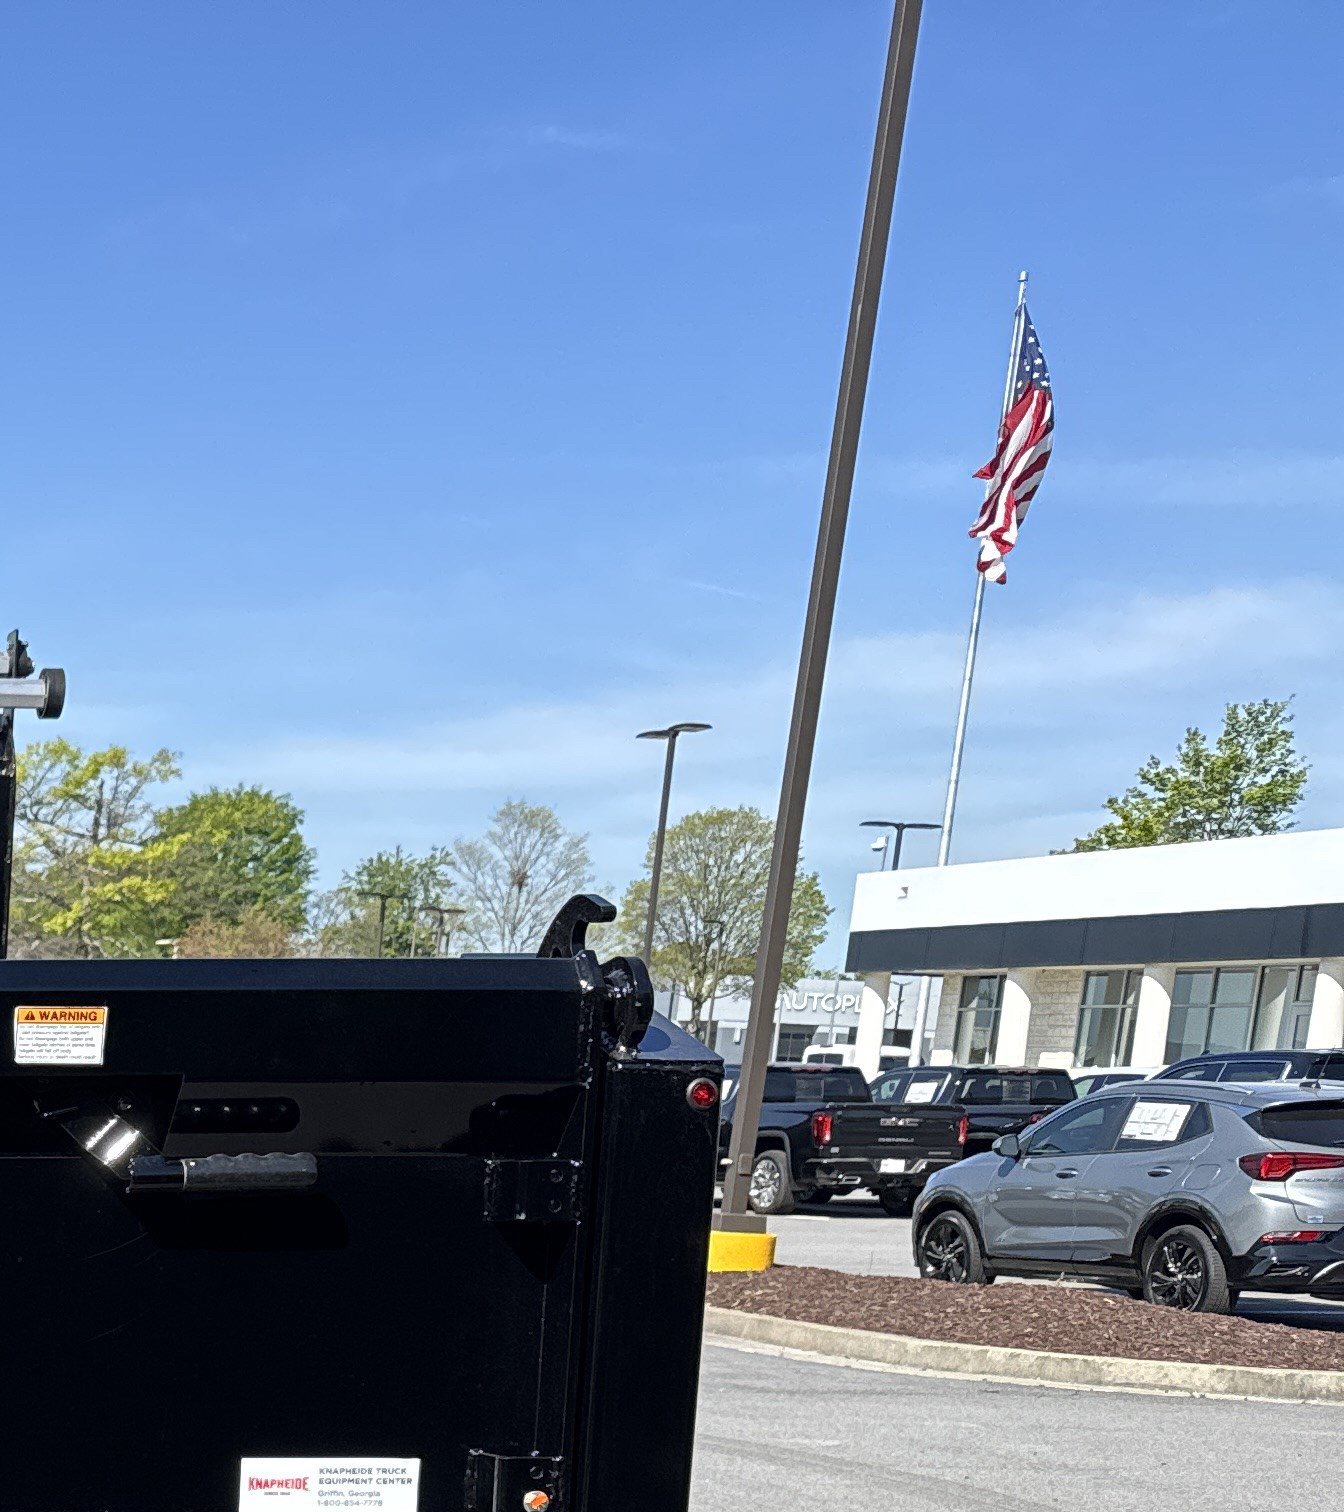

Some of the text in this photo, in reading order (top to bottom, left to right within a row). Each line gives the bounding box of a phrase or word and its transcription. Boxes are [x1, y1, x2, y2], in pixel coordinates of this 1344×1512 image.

[775, 991, 898, 1014] AUTOPLX
[39, 1011, 98, 1021] WARNING
[318, 1467, 407, 1475] KNAPHEIDE TRUCK
[248, 1476, 310, 1491] KNAPHEIDE
[318, 1477, 413, 1485] EQUIPMENT CENTER
